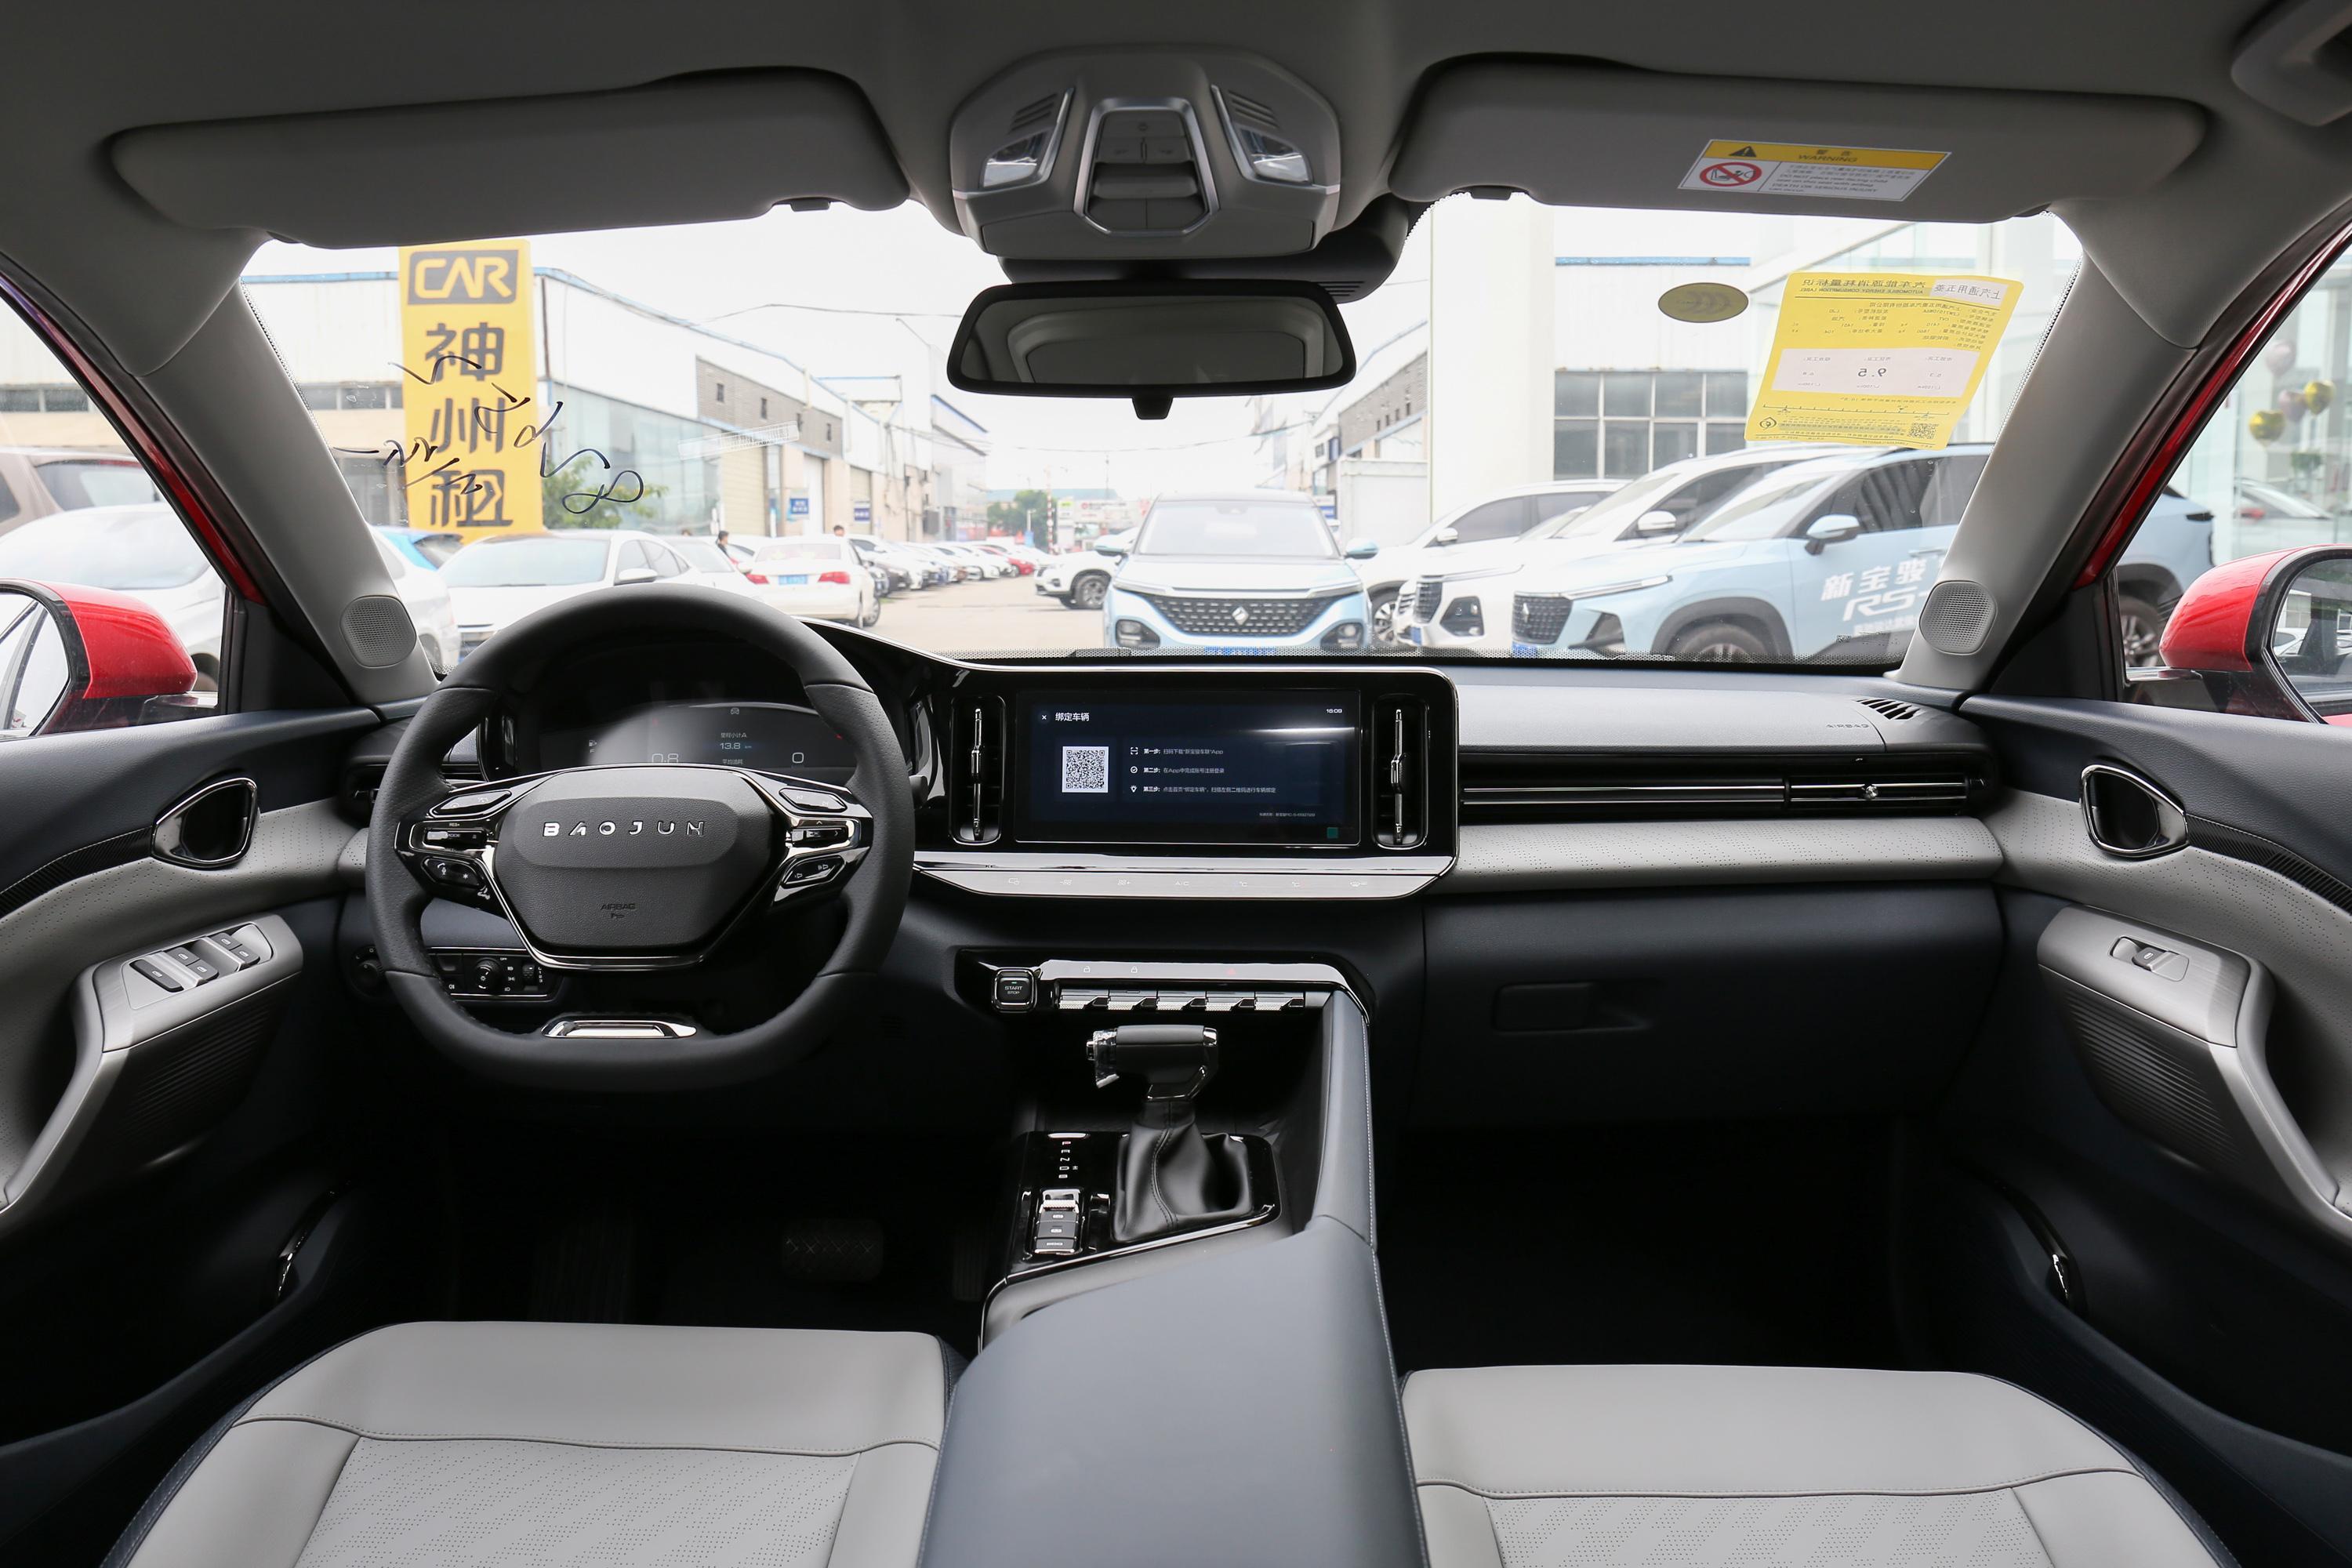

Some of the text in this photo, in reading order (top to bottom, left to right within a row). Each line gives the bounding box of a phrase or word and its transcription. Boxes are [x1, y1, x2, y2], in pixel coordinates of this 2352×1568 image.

[1798, 154, 1858, 163] WARNING
[414, 256, 513, 299] CAR
[1054, 712, 1090, 721] 绑定车辆
[543, 821, 705, 837] BAOJUN
